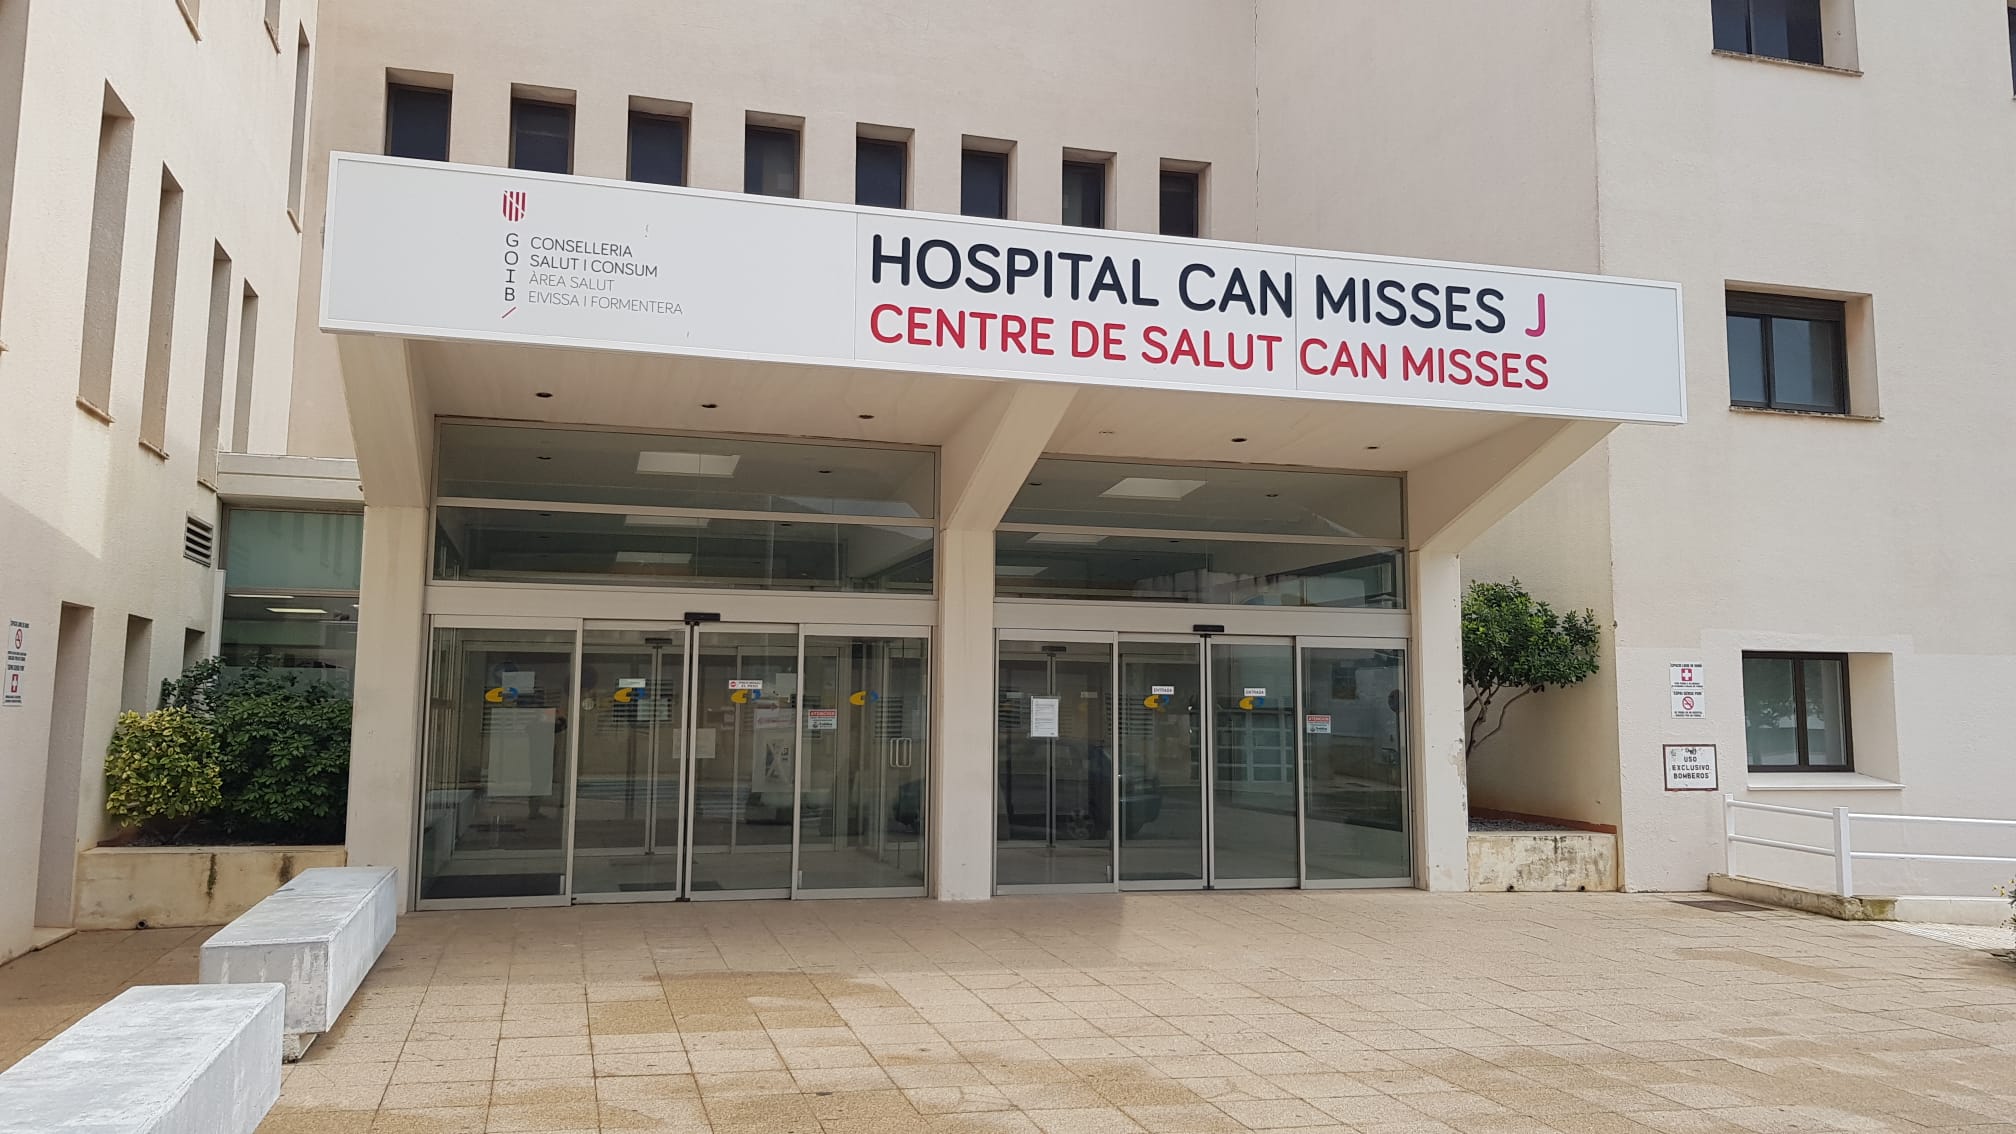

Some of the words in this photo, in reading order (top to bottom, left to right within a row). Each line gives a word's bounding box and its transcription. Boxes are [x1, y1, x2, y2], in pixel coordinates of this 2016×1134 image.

[530, 236, 633, 258] CONSELLERIA
[503, 232, 519, 302] GOIB
[529, 254, 580, 271] SALUT
[590, 259, 658, 278] CONSUM
[528, 270, 567, 288] ÀREA
[569, 276, 615, 292] SALUT
[871, 233, 1160, 307] HOSPITAL
[1178, 263, 1293, 319] CAN
[1315, 274, 1506, 334] MISSES
[528, 290, 580, 307] EIVISSA
[590, 295, 683, 315] FORMENTERA
[870, 303, 1055, 356] CENTRE
[1071, 320, 1127, 361] DE
[1141, 325, 1283, 372] SALUT
[1300, 338, 1387, 380] CAN
[1402, 345, 1549, 391] MISSES
[1673, 772, 1710, 780] BOMBEROS
